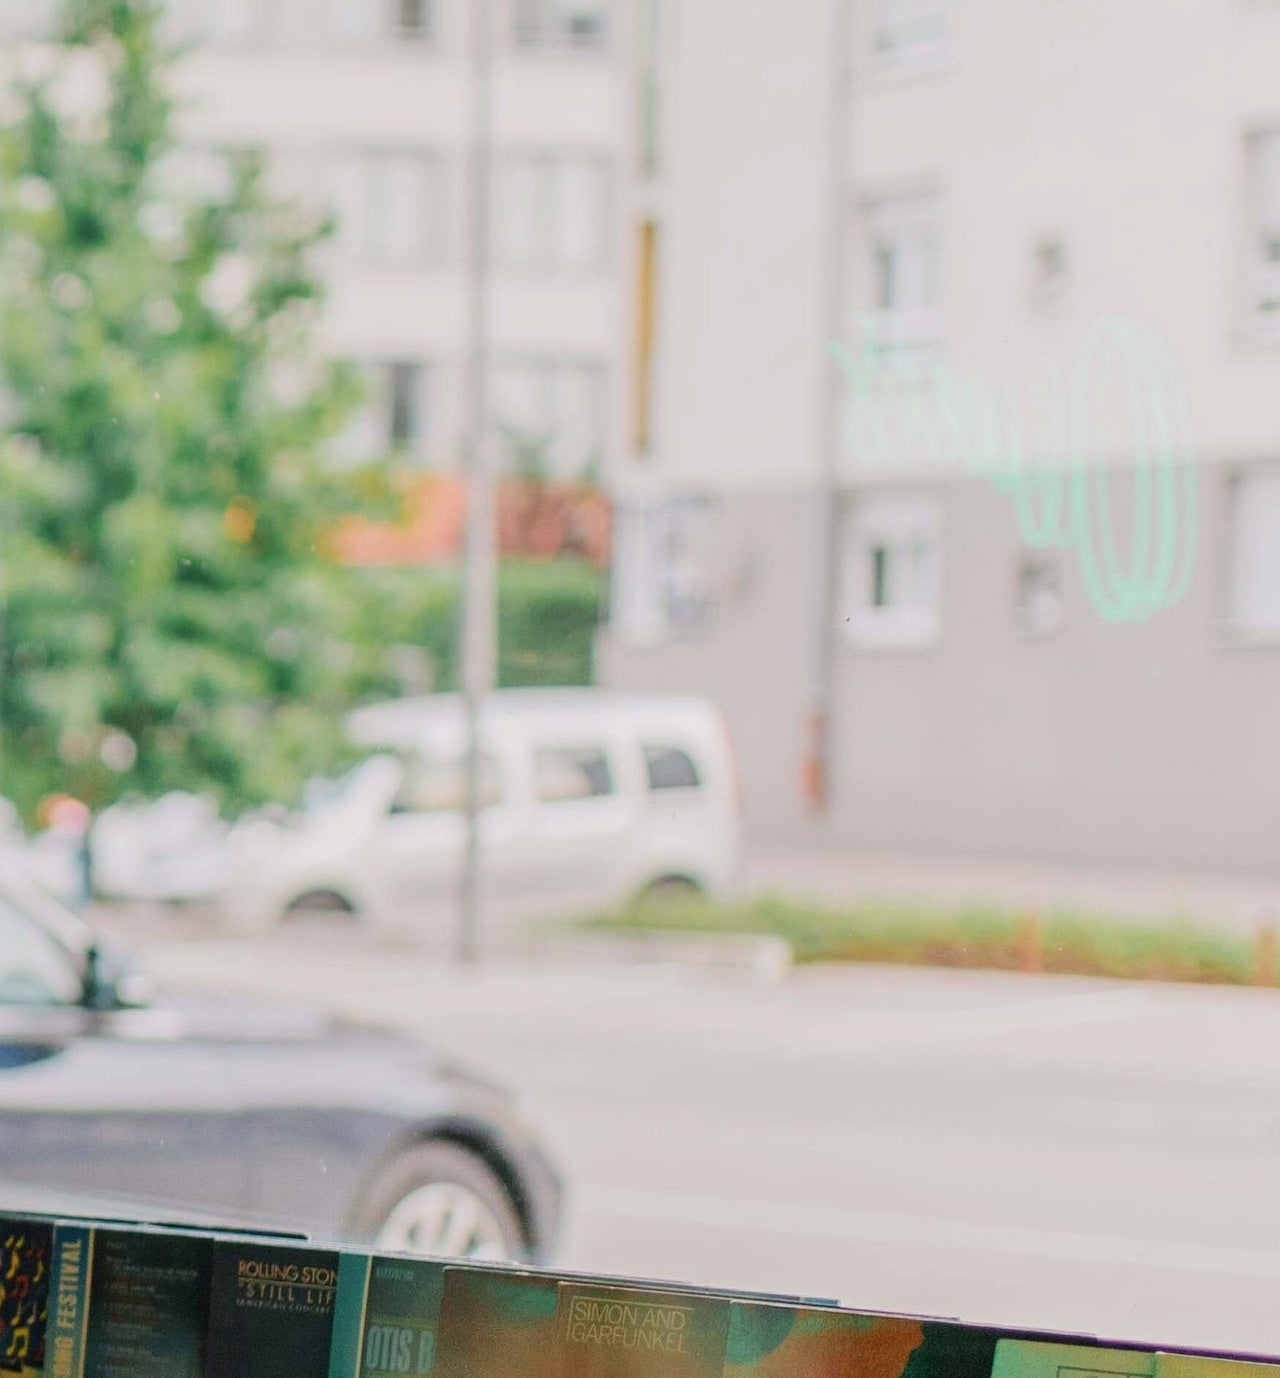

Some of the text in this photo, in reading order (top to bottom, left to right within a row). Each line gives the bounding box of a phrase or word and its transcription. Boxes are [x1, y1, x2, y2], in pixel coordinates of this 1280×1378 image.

[56, 1239, 82, 1329] FESTIVAL
[238, 1260, 299, 1283] ROLLING
[575, 1301, 686, 1330] SIMON AND
[366, 1325, 414, 1373] OTIS
[572, 1322, 689, 1353] GARFUNKEL
